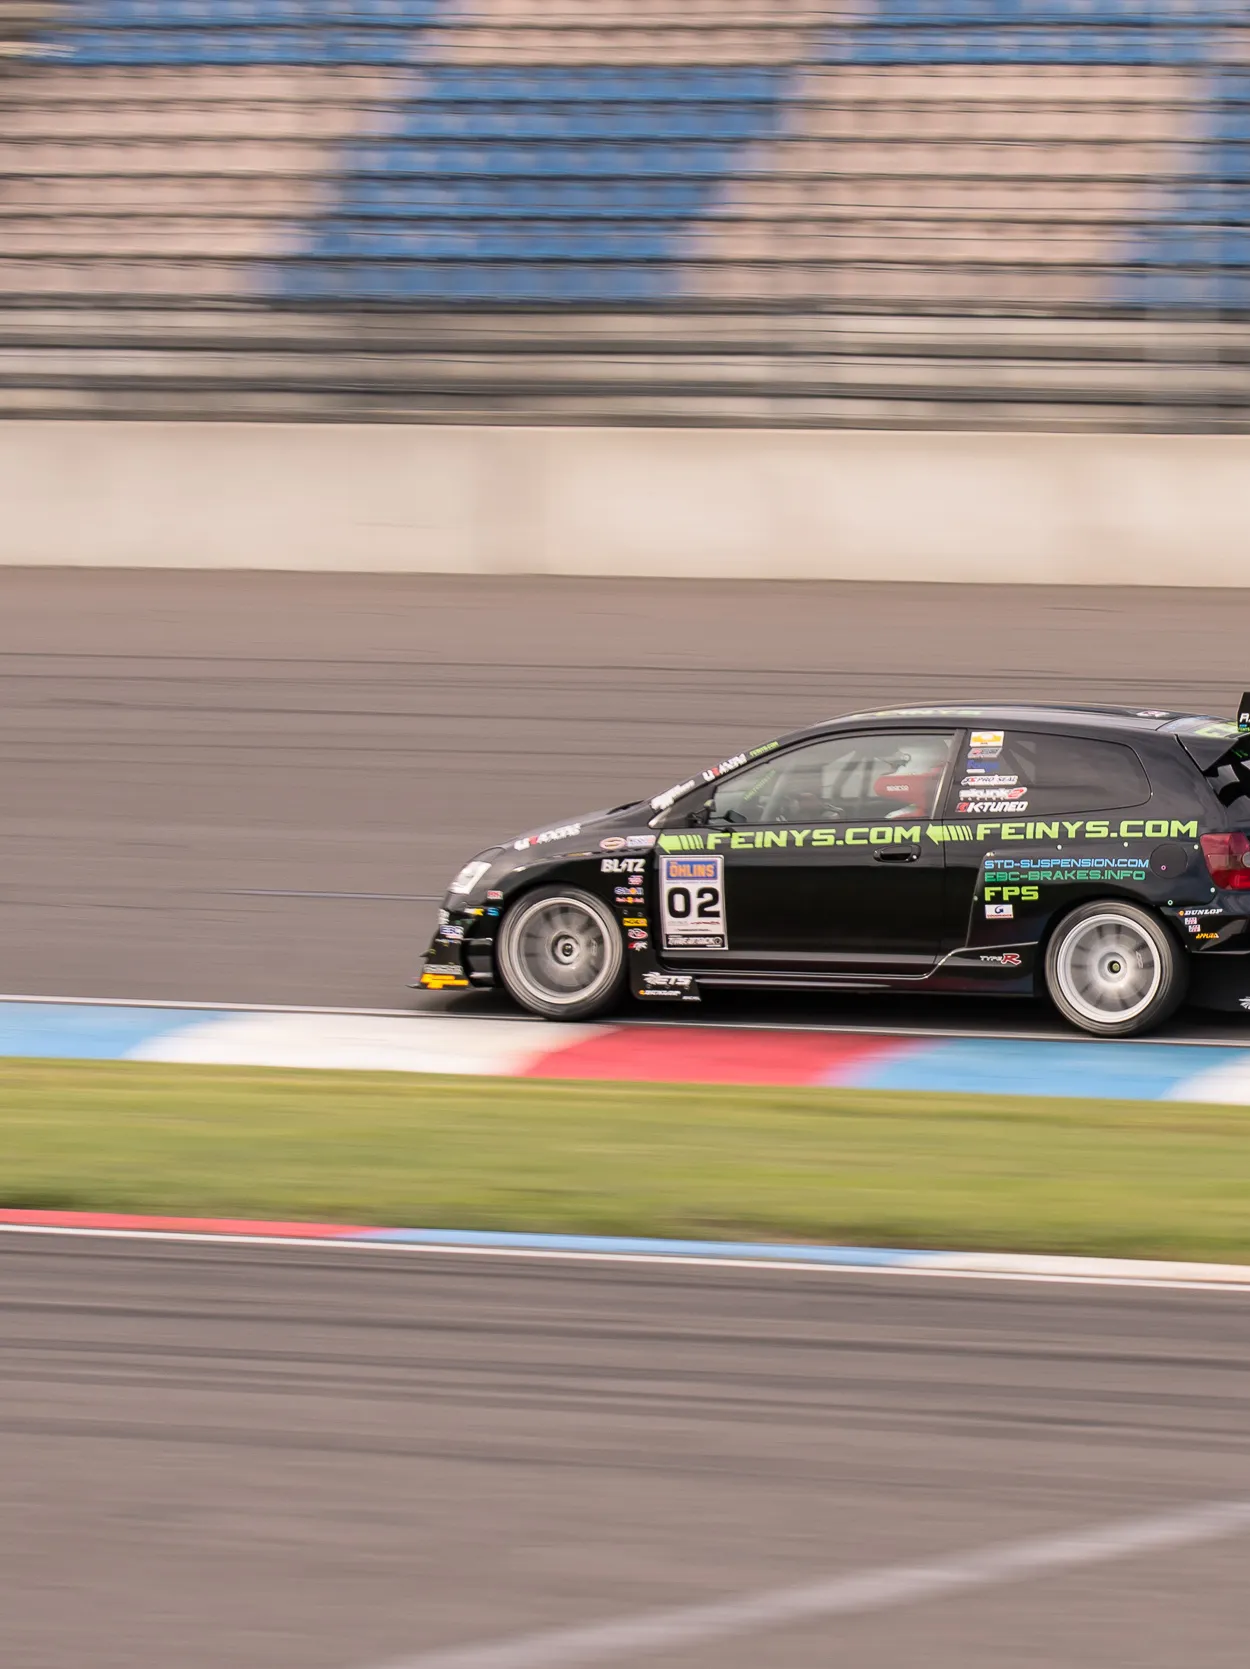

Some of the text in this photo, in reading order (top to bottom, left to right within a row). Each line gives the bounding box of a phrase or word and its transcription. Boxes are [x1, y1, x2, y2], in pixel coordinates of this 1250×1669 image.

[706, 825, 922, 850] FEINYS.COM
[976, 820, 1199, 841] FEINYS.COM
[600, 858, 646, 873] BLITZ
[668, 861, 716, 877] ÖHLINS
[984, 857, 1150, 869] STD-SUSPENSION.COM
[984, 869, 1146, 883] EBC-BRAKES.INFO
[984, 885, 1039, 901] FPS
[667, 887, 721, 919] 02
[1184, 908, 1223, 916] DUNLOP
[1000, 953, 1022, 966] R
